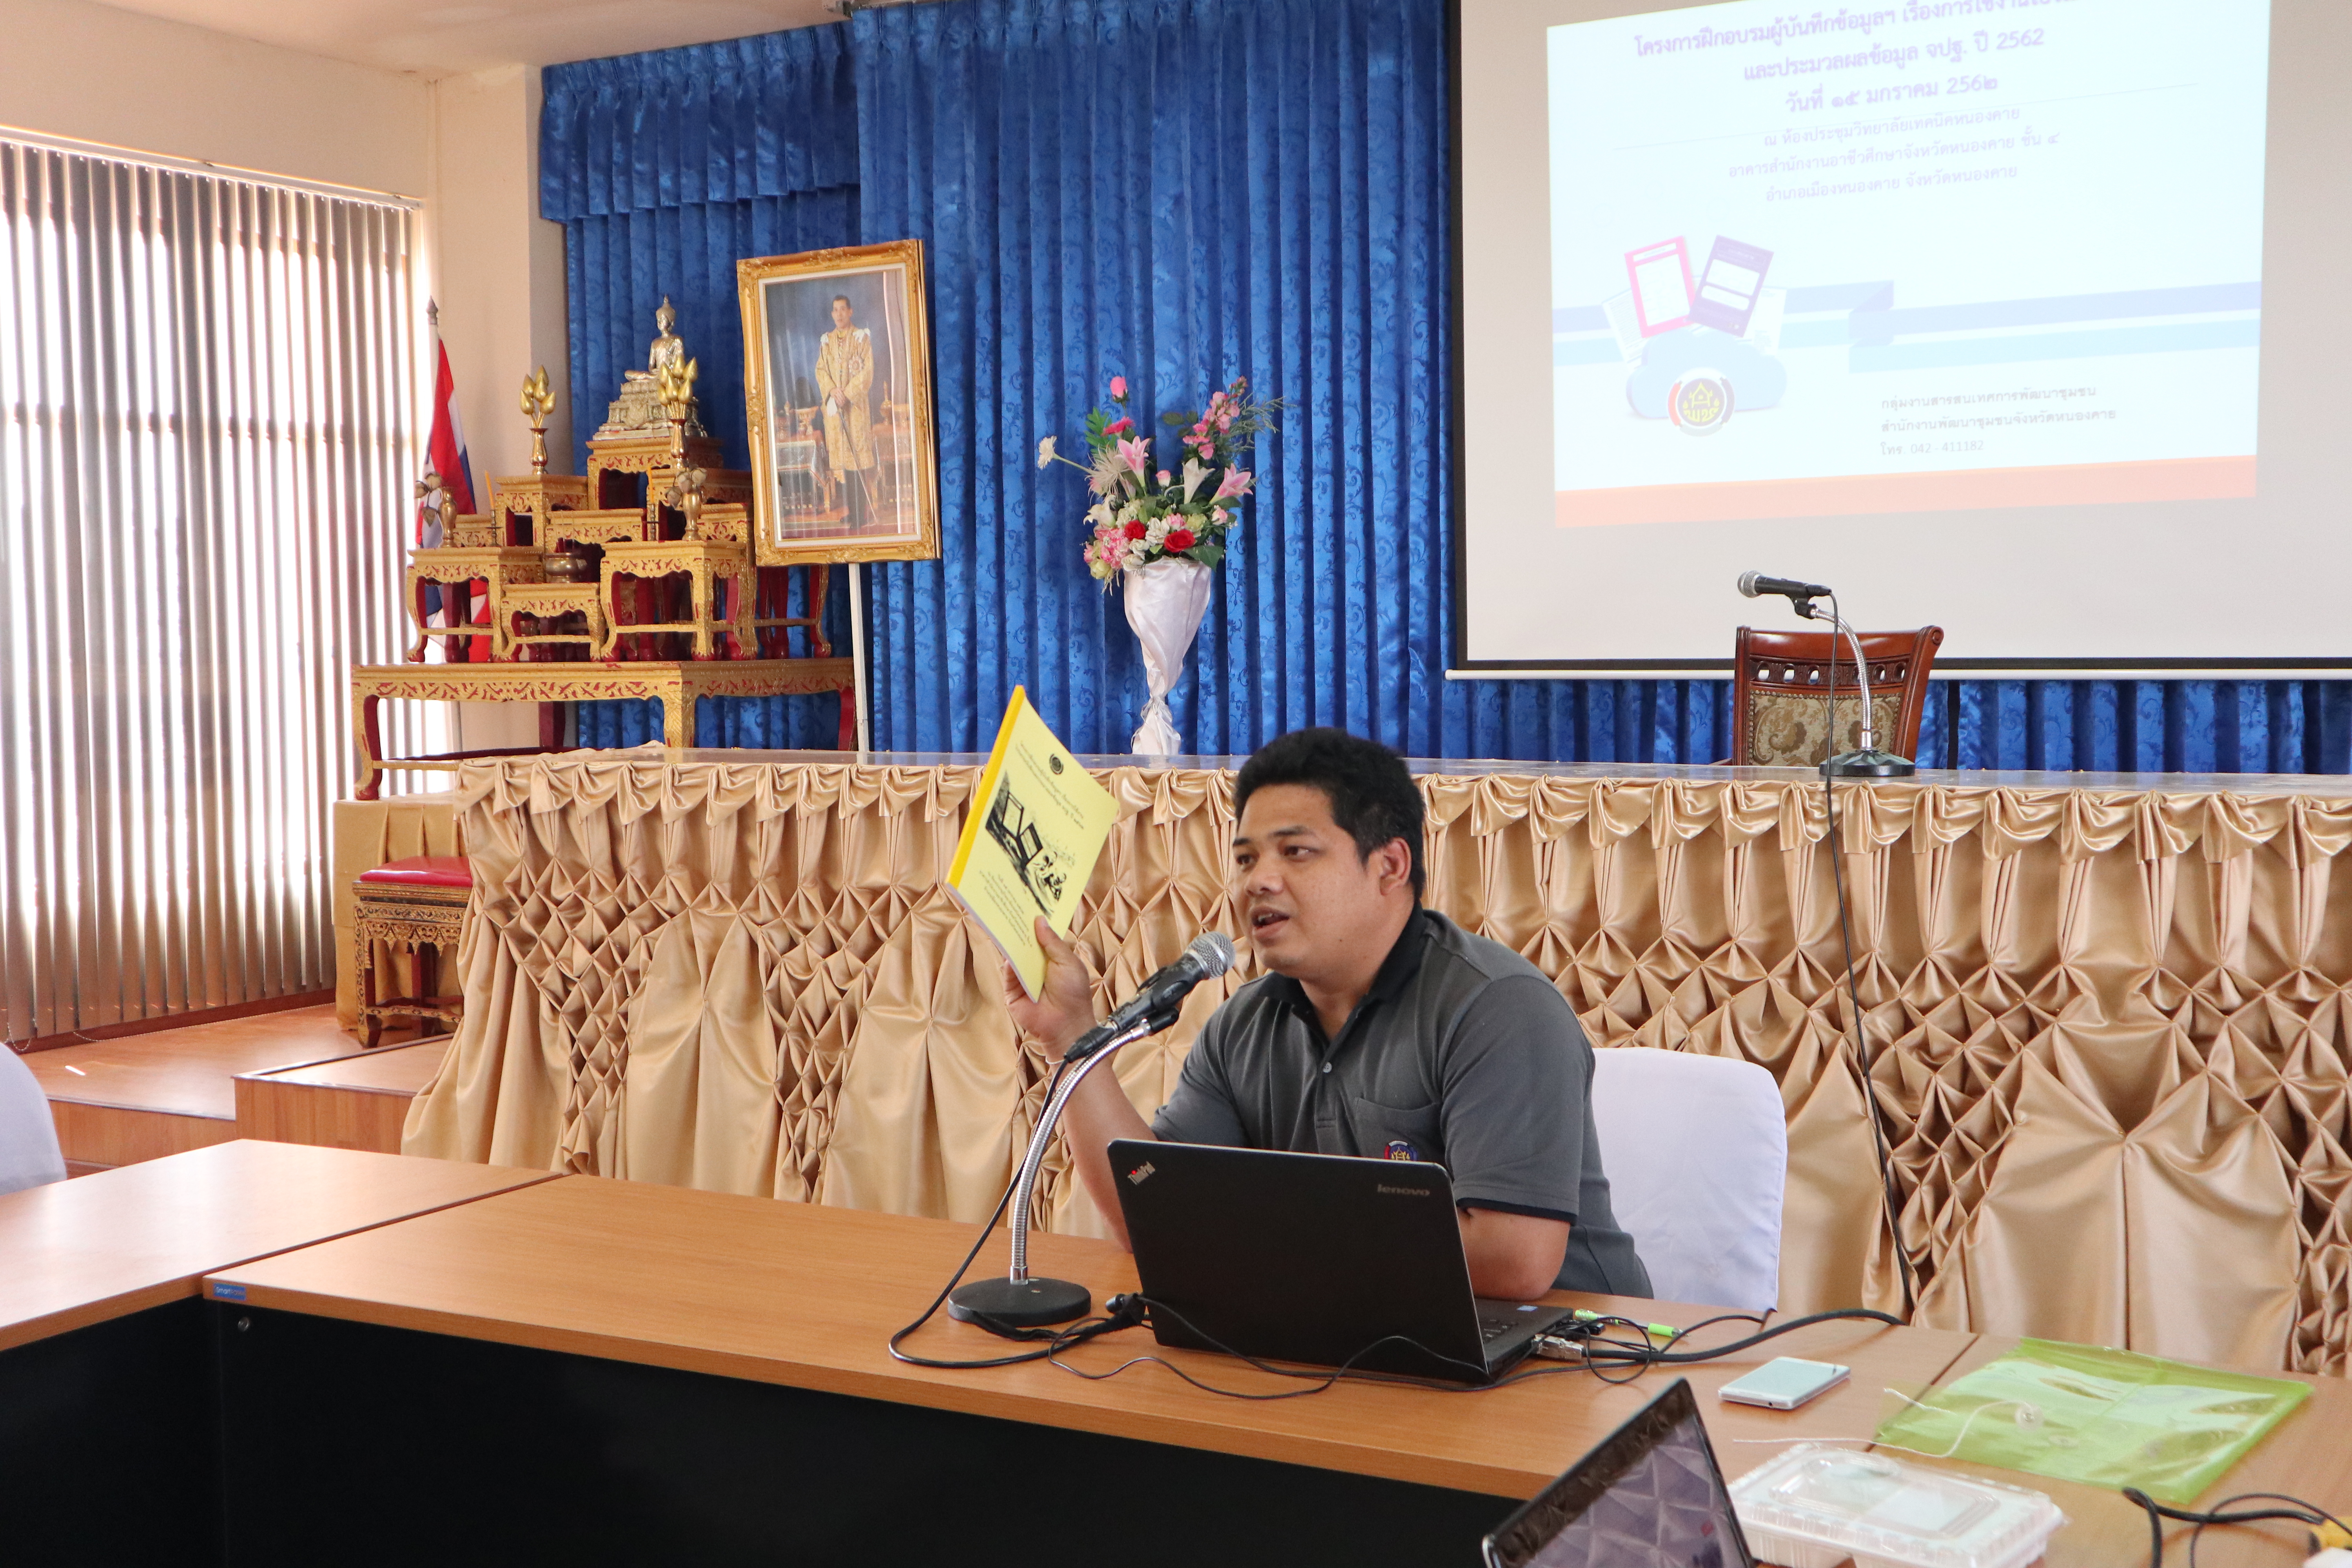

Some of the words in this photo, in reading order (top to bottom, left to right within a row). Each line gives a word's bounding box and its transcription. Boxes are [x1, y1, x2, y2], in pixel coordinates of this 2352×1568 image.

[1744, 43, 1918, 80] และประมวลผลข้อมูล
[1926, 37, 1967, 62] จปฐ.
[1973, 30, 1988, 52] ปี
[1996, 28, 2044, 50] 2562
[1786, 83, 1823, 112] วันที่
[1831, 91, 1860, 107] ๑๕
[1866, 82, 1938, 103] มกราคม
[1765, 136, 1777, 146] ณ
[2022, 126, 2041, 146] ชั้น
[2048, 133, 2059, 144] ๔
[1767, 179, 1899, 201] อำเภอเมืองหนองคาย
[1906, 166, 2017, 187] จังหวัดหนองคาย
[1910, 443, 1932, 454] 042
[1942, 441, 1983, 451] 411182
